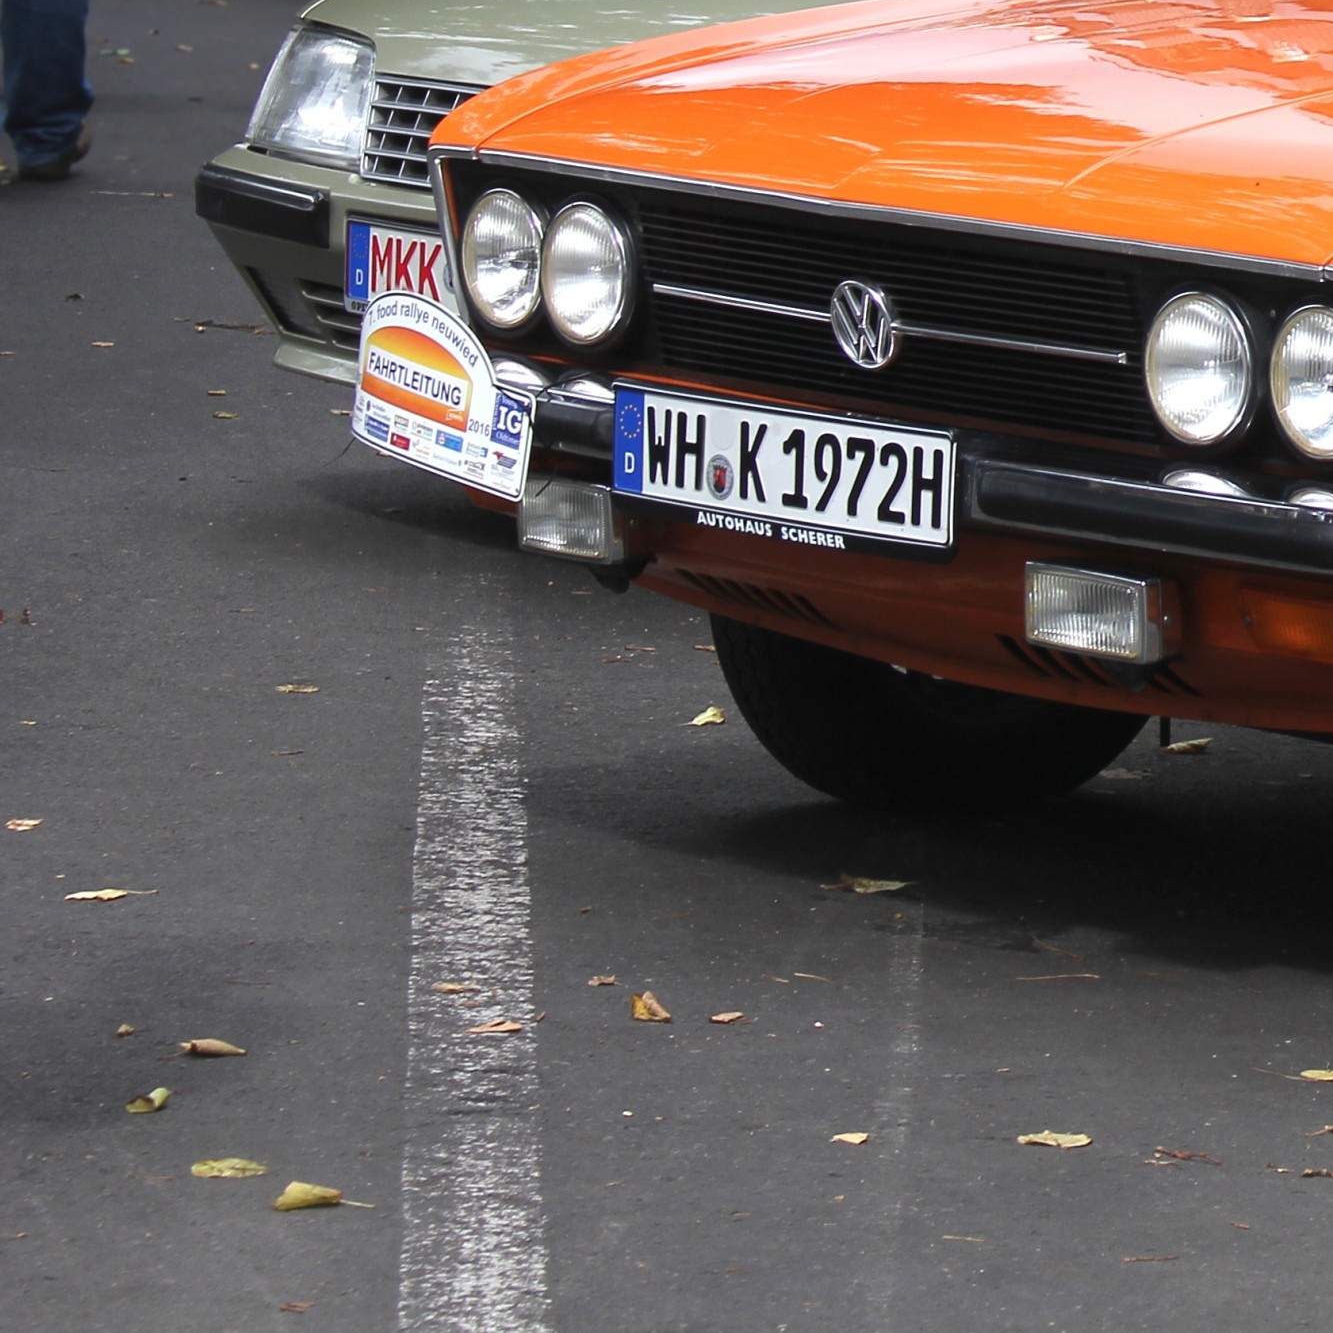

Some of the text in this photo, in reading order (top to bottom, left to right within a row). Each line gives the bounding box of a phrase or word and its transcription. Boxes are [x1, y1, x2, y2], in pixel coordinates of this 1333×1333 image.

[355, 269, 364, 286] D
[371, 234, 442, 303] MKK
[377, 300, 398, 320] food
[400, 302, 430, 324] rallye
[432, 315, 479, 368] neuwied
[368, 351, 462, 406] FAHRTLEITUNG
[468, 418, 490, 438] 2016
[496, 405, 522, 435] IG
[624, 451, 636, 475] D
[647, 405, 945, 529] WH K 1972H
[696, 510, 847, 550] AUTOHAUS SCHERER
